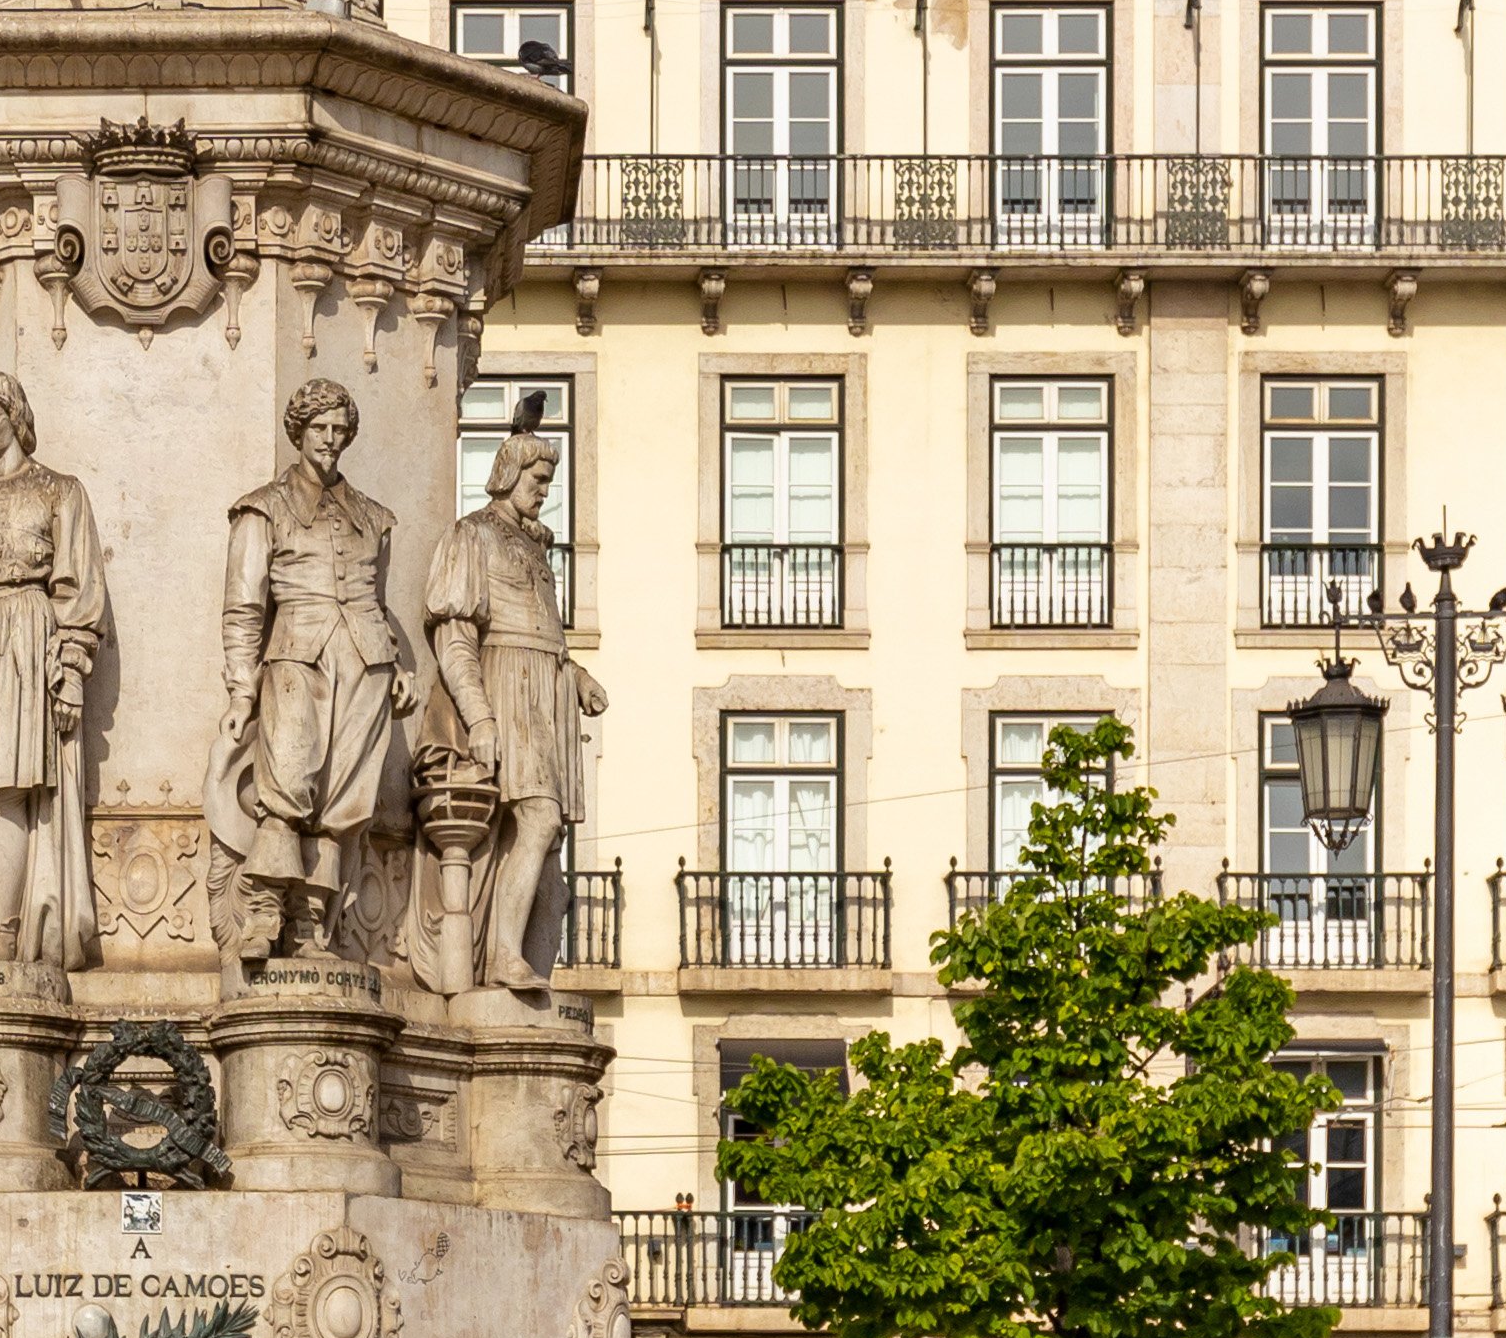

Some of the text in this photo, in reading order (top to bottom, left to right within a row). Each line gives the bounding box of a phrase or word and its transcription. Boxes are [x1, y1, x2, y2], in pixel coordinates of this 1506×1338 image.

[130, 1236, 152, 1259] A
[14, 1274, 84, 1298] LUIZ
[92, 1274, 132, 1298] DE
